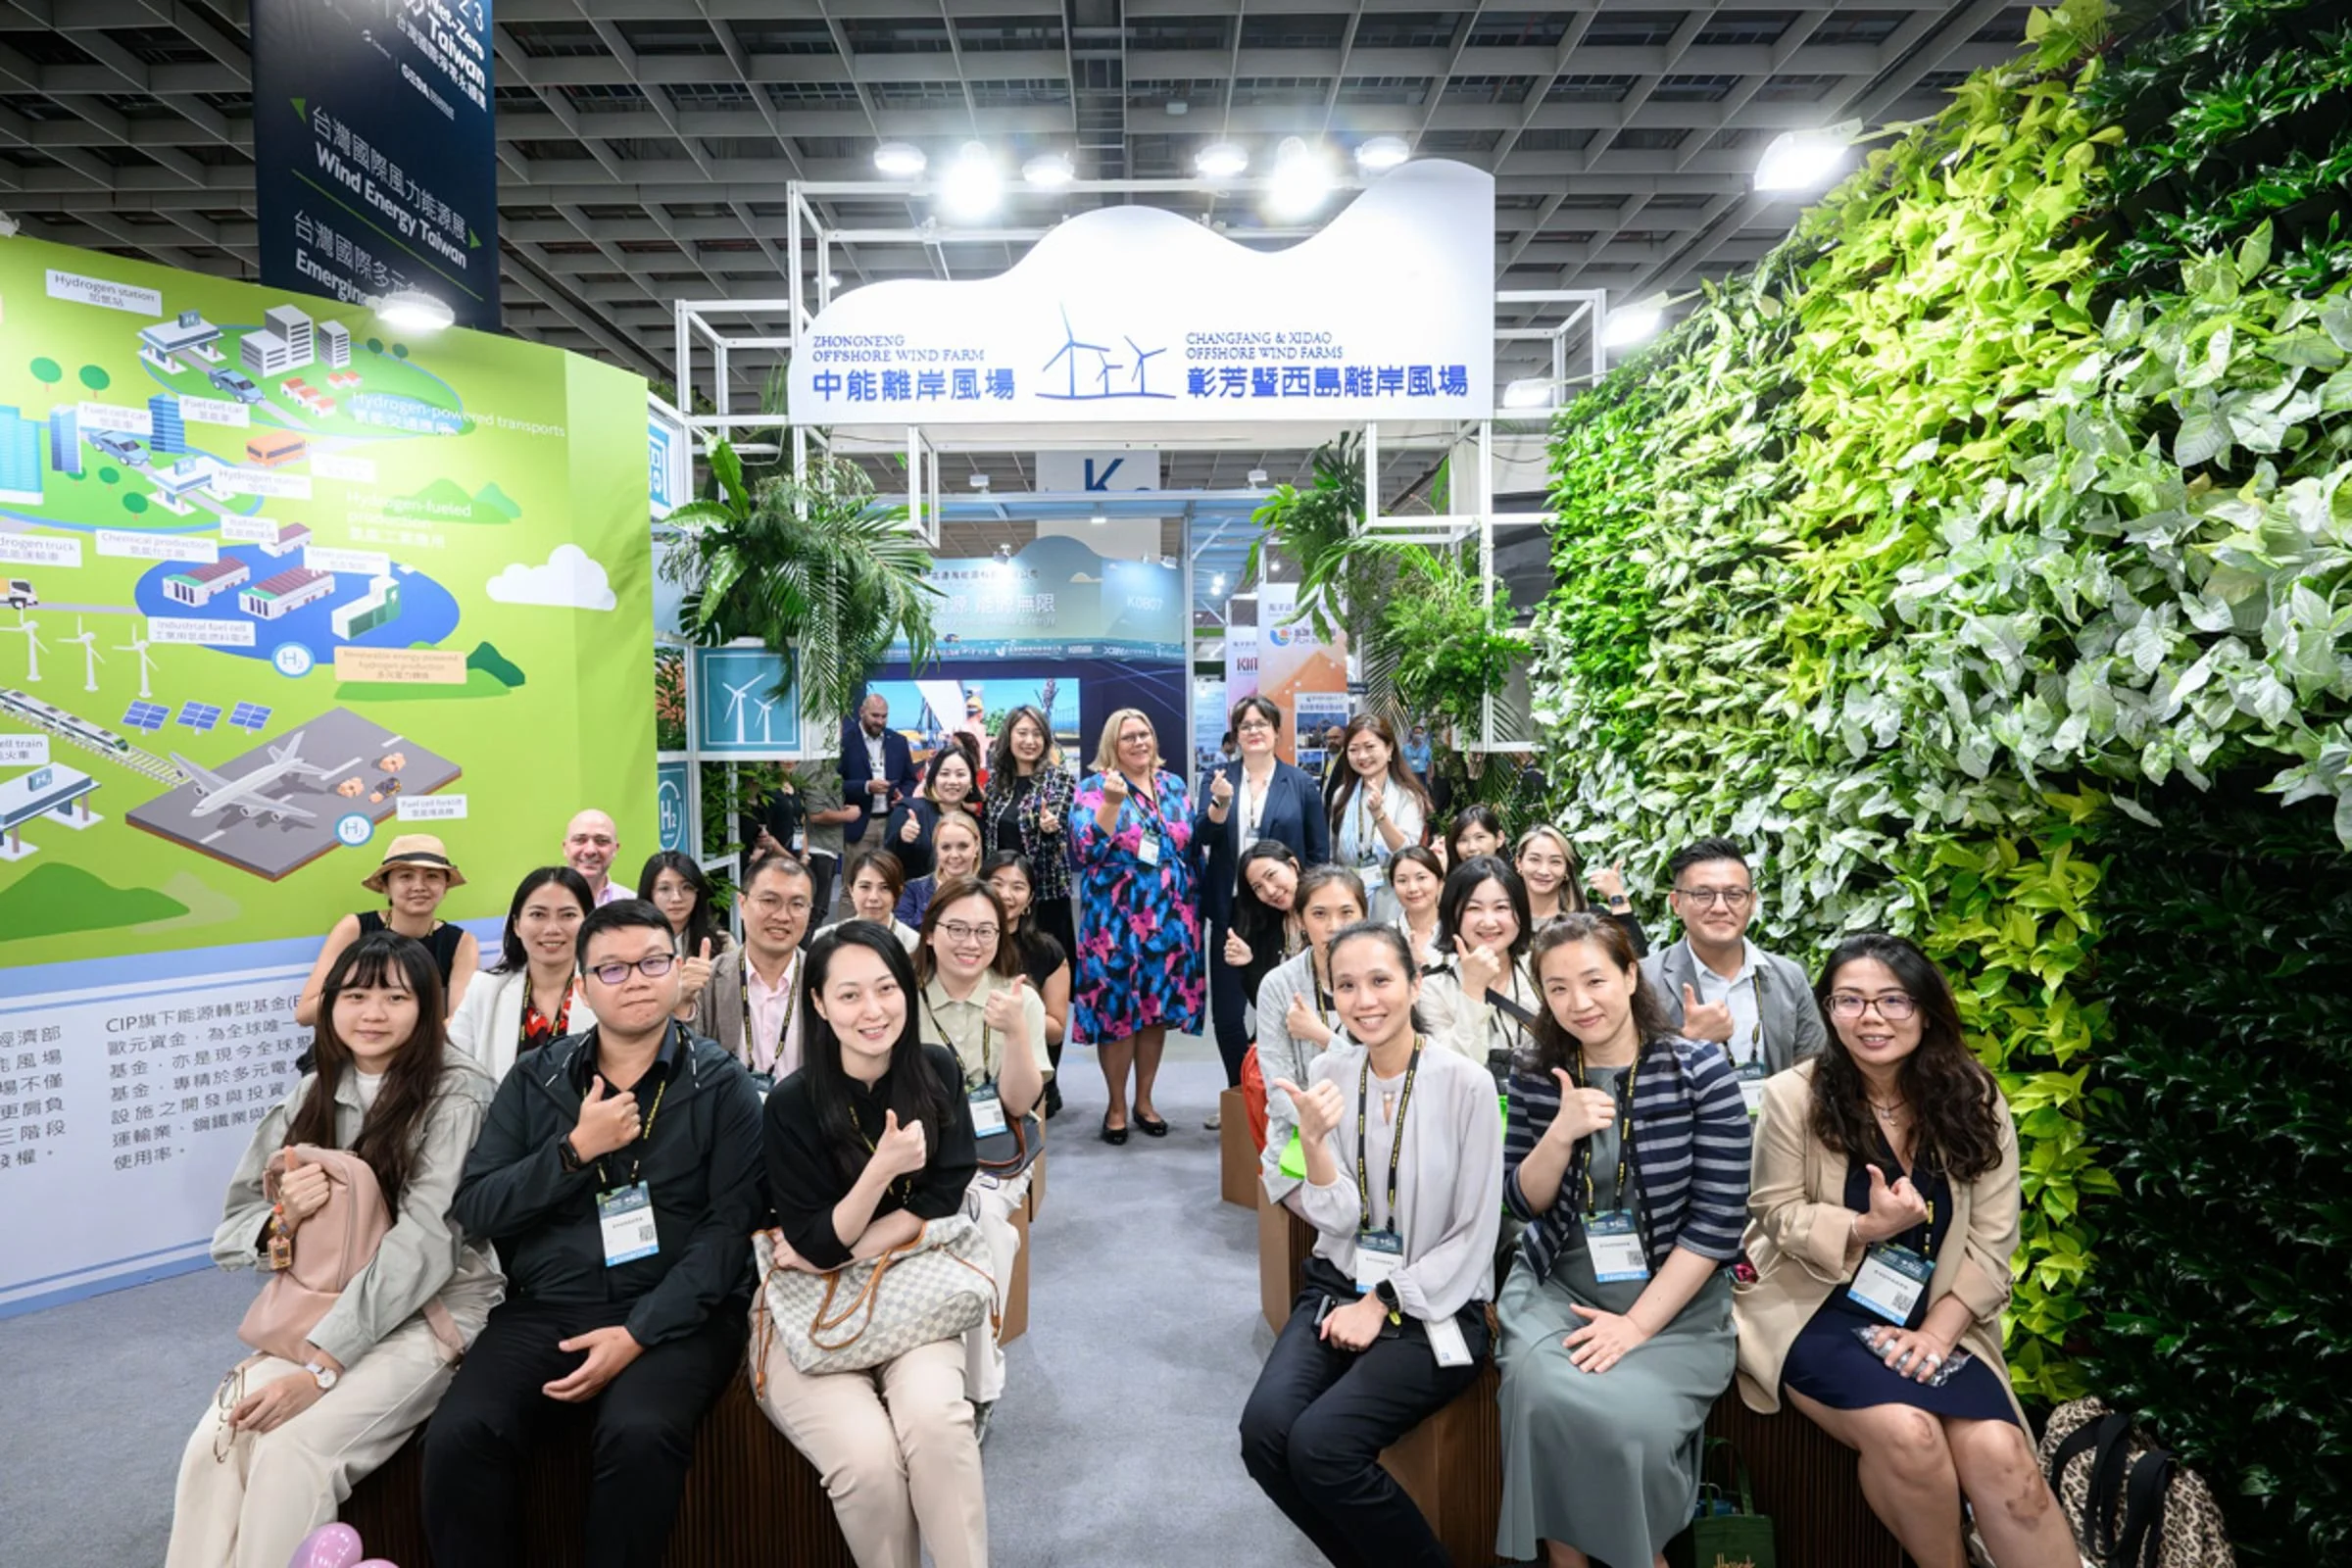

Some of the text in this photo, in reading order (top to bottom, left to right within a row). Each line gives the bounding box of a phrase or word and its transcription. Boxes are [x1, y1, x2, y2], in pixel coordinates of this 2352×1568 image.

[428, 12, 486, 90] Taiwan
[314, 106, 467, 244] 台灣國際風力能源展
[316, 142, 467, 269] Wind Energy Taiwan
[294, 210, 417, 293] 台灣國際多元
[55, 273, 155, 302] Hydrogen station
[812, 334, 906, 348] ZHONGNENG
[1186, 331, 1333, 345] CHANGFANG & XIDAO
[812, 349, 985, 363] OFFSHORE WIND FARM
[1186, 346, 1343, 360] OFFSHORE WIND FARMS
[812, 368, 1015, 402] 中能離岸風場
[1187, 365, 1469, 399] 彰芳暨西島離岸風場
[353, 391, 565, 438] Hydrogen-powered transports
[219, 469, 271, 483] Hydrogen
[1085, 458, 1124, 491] K
[45, 540, 75, 552] truck
[102, 532, 212, 549] Chemical production
[157, 619, 247, 633] Industrial fuel cell
[15, 739, 43, 749] train
